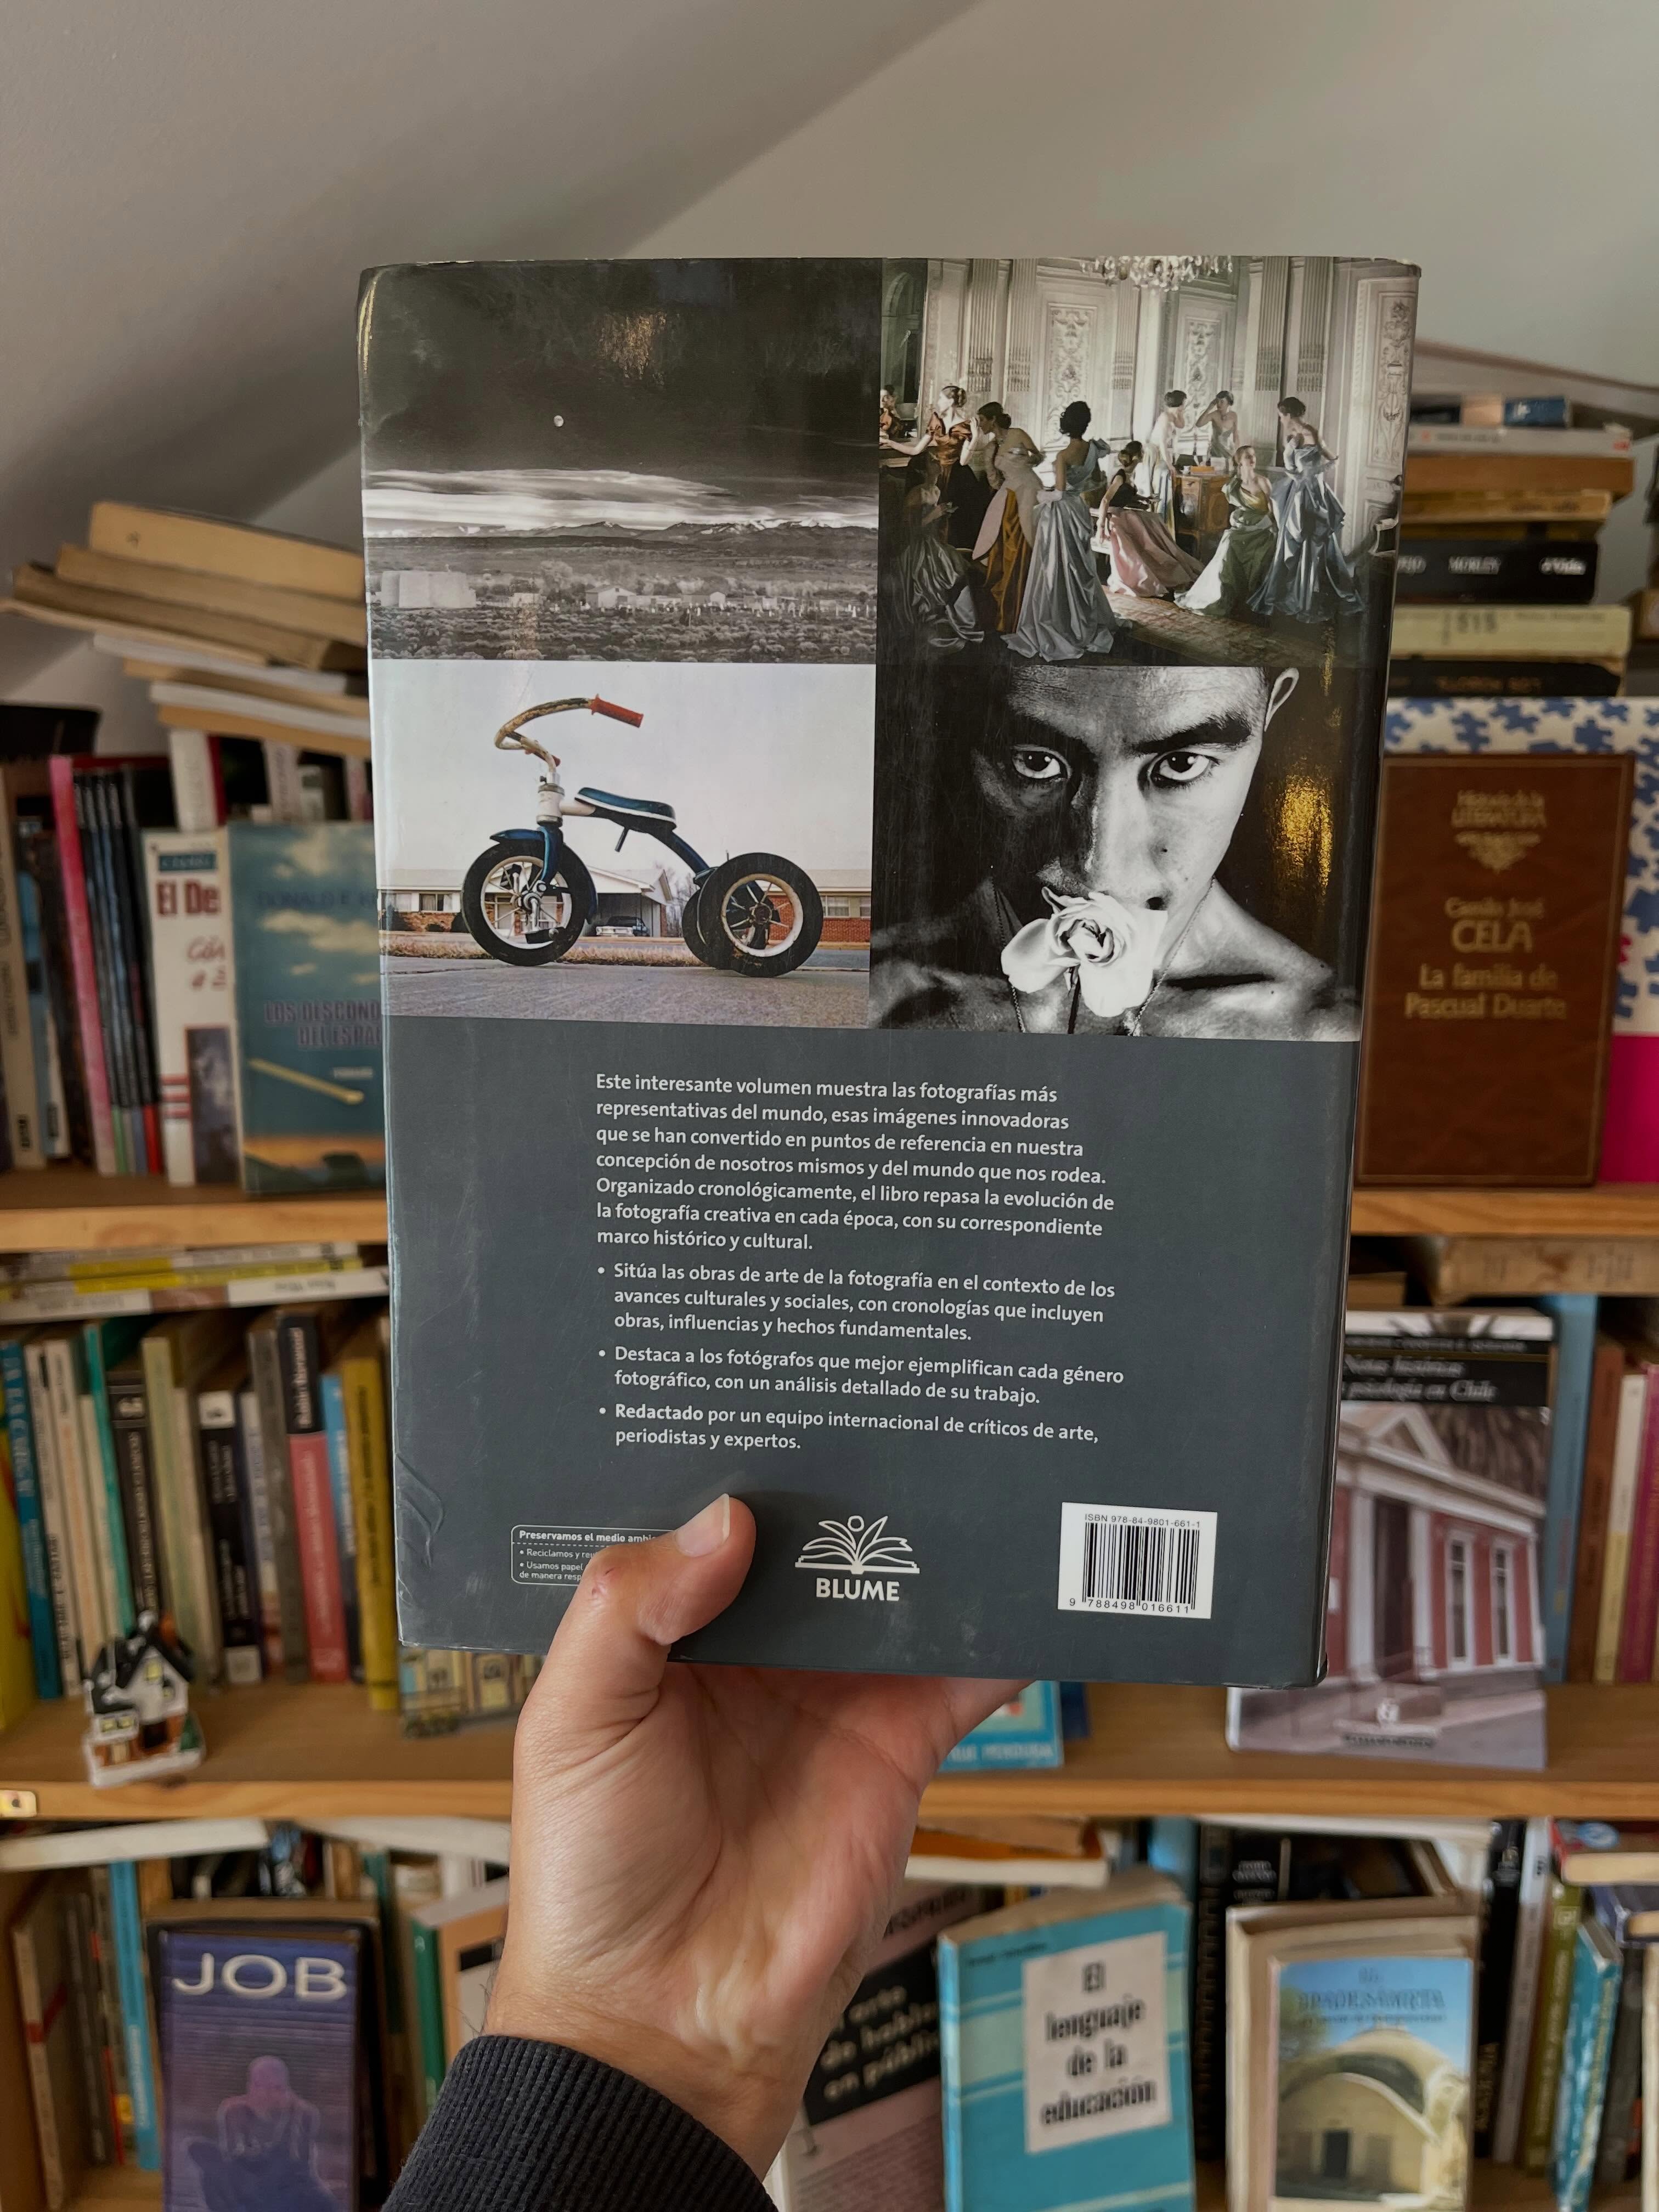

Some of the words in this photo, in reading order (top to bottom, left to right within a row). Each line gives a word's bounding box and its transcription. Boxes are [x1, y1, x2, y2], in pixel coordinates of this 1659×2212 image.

[1452, 919, 1533, 953] CELA
[596, 1073, 631, 1090] Este
[635, 1074, 732, 1093] interesante
[736, 1077, 811, 1095] volumen
[816, 1081, 887, 1097] muestra
[892, 1081, 916, 1098] las
[919, 1082, 1017, 1104] fotografías
[1020, 1086, 1057, 1102] más
[596, 1102, 727, 1120] representativas
[731, 1103, 757, 1120] del
[762, 1105, 827, 1125] mundo,
[831, 1110, 868, 1123] esas
[873, 1107, 957, 1129] imágenes
[961, 1110, 1069, 1130] innovadoras
[596, 1129, 628, 1146] que
[632, 1130, 650, 1142] se
[654, 1126, 686, 1143] han
[690, 1130, 782, 1147] convertido
[785, 1135, 806, 1147] en
[811, 1133, 871, 1152] puntos
[874, 1133, 896, 1150] de
[900, 1134, 986, 1152] referencia
[990, 1141, 1012, 1153] en
[1017, 1141, 1083, 1156] nuestra
[596, 1153, 691, 1173] concepción
[695, 1154, 715, 1170] de
[720, 1157, 794, 1172] nosotros
[798, 1158, 865, 1175] mismos
[867, 1163, 878, 1180] y
[882, 1159, 908, 1176] del
[913, 1161, 975, 1178] mundo
[978, 1167, 1012, 1183] que
[1016, 1169, 1047, 1181] nos
[1051, 1166, 1106, 1184] rodea.
[596, 1177, 695, 1198] Organizado
[698, 1181, 857, 1203] cronológicamente,
[861, 1184, 876, 1200] el
[881, 1185, 919, 1202] libro
[923, 1191, 980, 1207] repasa
[985, 1188, 999, 1205] la
[1003, 1190, 1088, 1209] evolución
[1092, 1193, 1114, 1210] de
[597, 1202, 611, 1218] la
[614, 1203, 699, 1224] fotografía
[704, 1207, 770, 1223] creativa
[775, 1212, 795, 1223] en
[799, 1209, 839, 1225] cada
[843, 1210, 899, 1230] época,
[902, 1216, 932, 1228] con
[937, 1217, 956, 1229] su
[960, 1217, 1103, 1236] correspondiente
[597, 1232, 650, 1244] marco
[653, 1229, 726, 1247] histórico
[729, 1236, 740, 1252] y
[743, 1232, 812, 1250] cultural.
[614, 1262, 657, 1279] Sitúa
[662, 1263, 685, 1279] las
[689, 1265, 735, 1281] obras
[740, 1266, 760, 1282] de
[764, 1268, 799, 1283] arte
[803, 1268, 824, 1284] de
[829, 1269, 843, 1285] la
[848, 1269, 933, 1291] fotografía
[938, 1277, 958, 1289] en
[963, 1274, 978, 1290] el
[983, 1277, 1060, 1294] contexto
[1064, 1279, 1086, 1296] de
[1091, 1280, 1115, 1297] los
[614, 1291, 680, 1305] avances
[684, 1290, 766, 1307] culturales
[769, 1296, 781, 1312] y
[784, 1294, 854, 1313] sociales,
[858, 1299, 887, 1312] con
[892, 1298, 990, 1319] cronologías
[994, 1305, 1026, 1322] que
[1031, 1303, 1103, 1325] incluyen
[614, 1312, 664, 1331] obras,
[669, 1313, 759, 1332] influencias
[761, 1321, 773, 1336] y
[777, 1317, 835, 1335] hechos
[838, 1319, 972, 1341] fundamentales.
[615, 1346, 680, 1362] Destaca
[685, 1351, 695, 1363] a
[700, 1348, 723, 1364] los
[726, 1348, 814, 1370] fotógrafos
[819, 1357, 850, 1373] que
[855, 1355, 905, 1375] mejor
[908, 1357, 1013, 1378] ejemplifican
[1018, 1363, 1058, 1379] cada
[1063, 1365, 1124, 1385] género
[614, 1369, 710, 1391] fotográfico,
[715, 1377, 744, 1389] con
[749, 1378, 770, 1390] un
[775, 1376, 837, 1393] análisis
[841, 1378, 921, 1397] detallado
[926, 1382, 946, 1398] de
[951, 1387, 969, 1399] su
[974, 1385, 1040, 1407] trabajo.
[616, 1403, 703, 1421] Redactado
[708, 1410, 736, 1425] por
[740, 1411, 761, 1423] un
[765, 1409, 823, 1429] equipo
[828, 1411, 939, 1431] internacional
[943, 1417, 964, 1432] de
[968, 1418, 1029, 1437] críticos
[1033, 1422, 1054, 1438] de
[1058, 1425, 1098, 1444] arte,
[616, 1427, 707, 1446] periodistas
[709, 1434, 720, 1450] y
[724, 1434, 801, 1451] expertos.
[1085, 1514, 1108, 1522] ISBN
[1111, 1515, 1200, 1527] 978-84-9801-661-1
[519, 1530, 582, 1542] Preservamos
[584, 1533, 594, 1541] el
[596, 1533, 625, 1542] medio
[628, 1534, 656, 1543] ambi
[526, 1549, 573, 1558] Reciclamos
[526, 1561, 560, 1570] Usamos
[561, 1562, 583, 1572] papel
[519, 1571, 529, 1579] de
[564, 1573, 582, 1582] resp
[816, 1577, 900, 1601] BLUME
[172, 1952, 348, 2003] JOB
